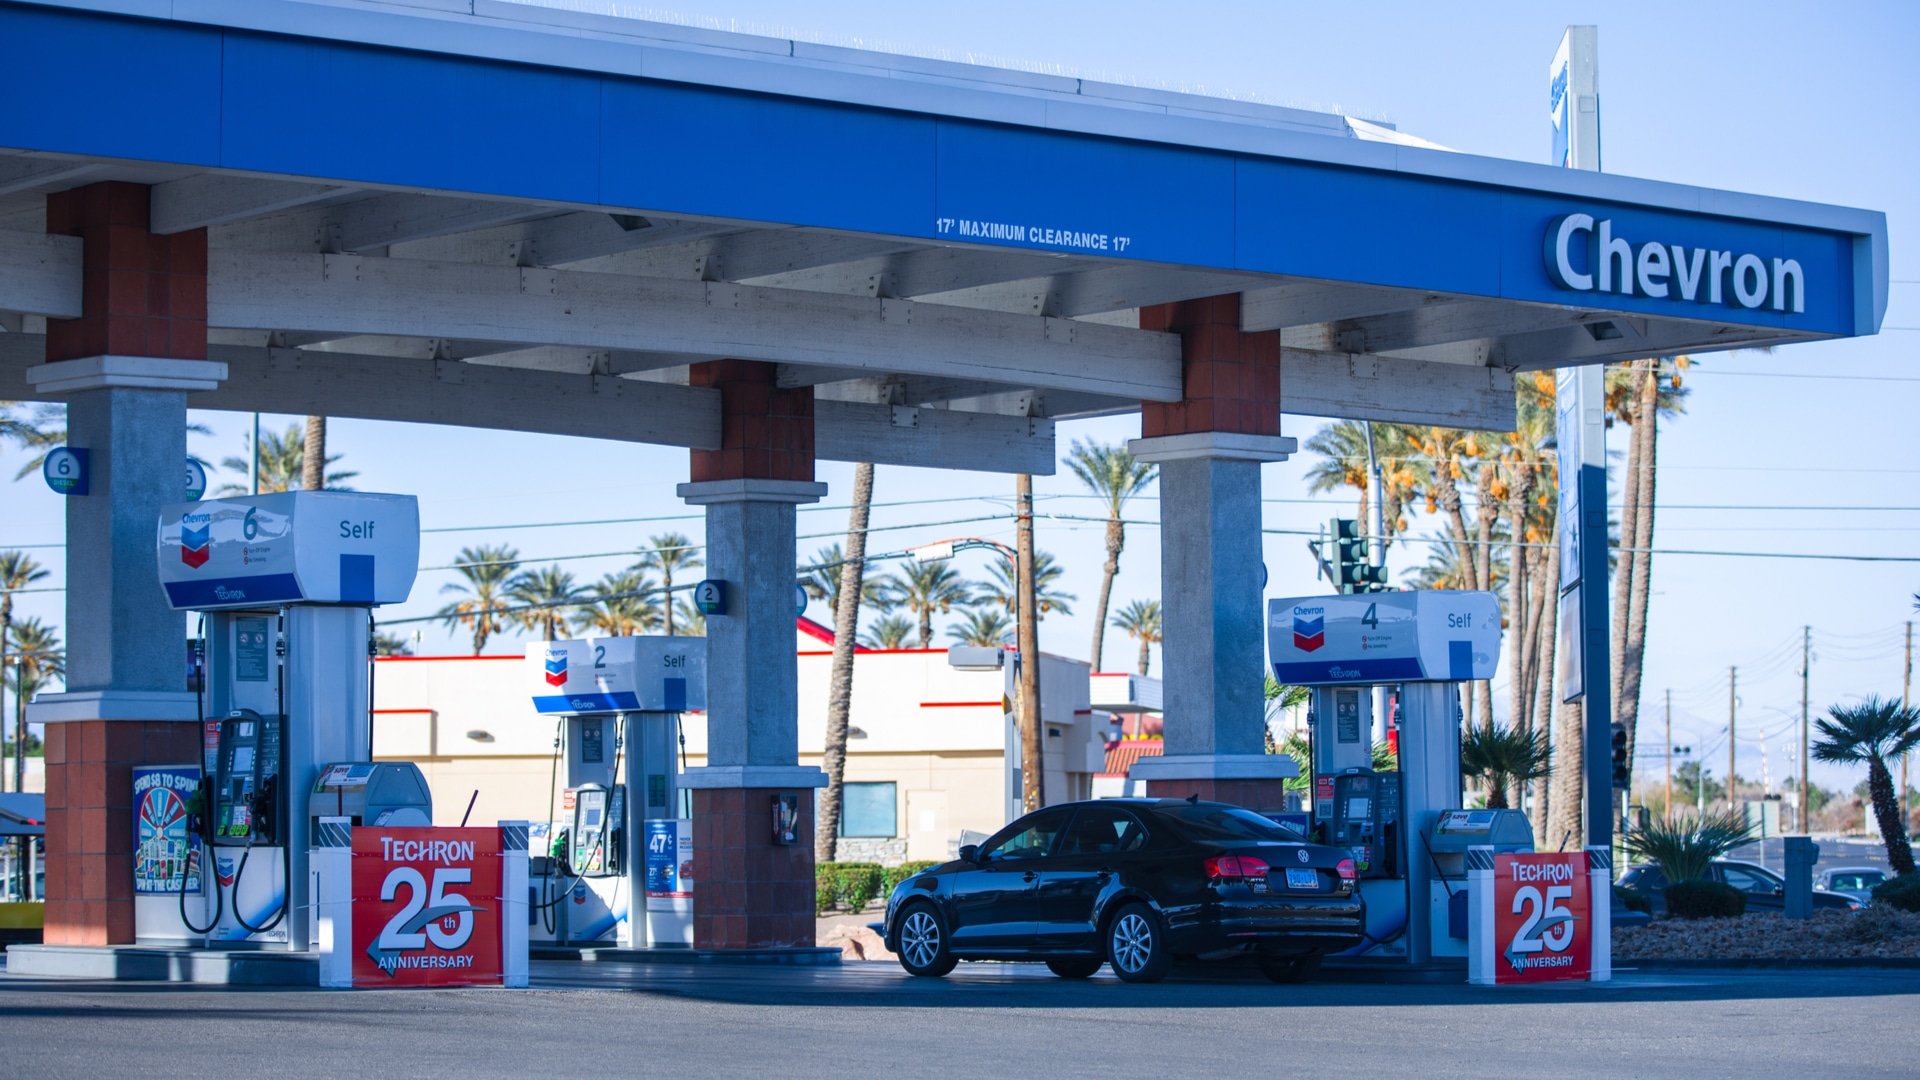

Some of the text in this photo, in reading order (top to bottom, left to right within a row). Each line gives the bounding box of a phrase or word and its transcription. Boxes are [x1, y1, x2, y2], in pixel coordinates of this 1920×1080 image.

[936, 218, 1131, 252] 17' MAXIMUM CLEARANCE 17'
[1553, 213, 1805, 313] Chevron
[57, 458, 70, 476] 6
[53, 479, 74, 487] DIESEL
[182, 512, 211, 524] Chevron
[243, 506, 258, 541] 6
[340, 520, 375, 539] Self
[214, 589, 246, 600] TECHRON
[704, 587, 713, 600] 2
[1293, 606, 1324, 616] Chevron
[1361, 602, 1379, 630] 4
[1448, 613, 1472, 629] Self
[594, 645, 606, 669] 2
[663, 655, 686, 668] Self
[1328, 669, 1361, 679] TECHRON
[135, 774, 151, 795] SPEND
[151, 773, 162, 787] $8
[162, 773, 173, 788] TO
[380, 837, 475, 866] TECHRON
[1510, 861, 1575, 885] TECHRON
[153, 879, 166, 892] THE
[166, 877, 199, 891] CASIER
[378, 866, 475, 951] 25 th
[1511, 885, 1575, 952] 25 th
[377, 954, 475, 970] ANNIVERSARY
[1511, 955, 1574, 969] ANNIVERSARY
